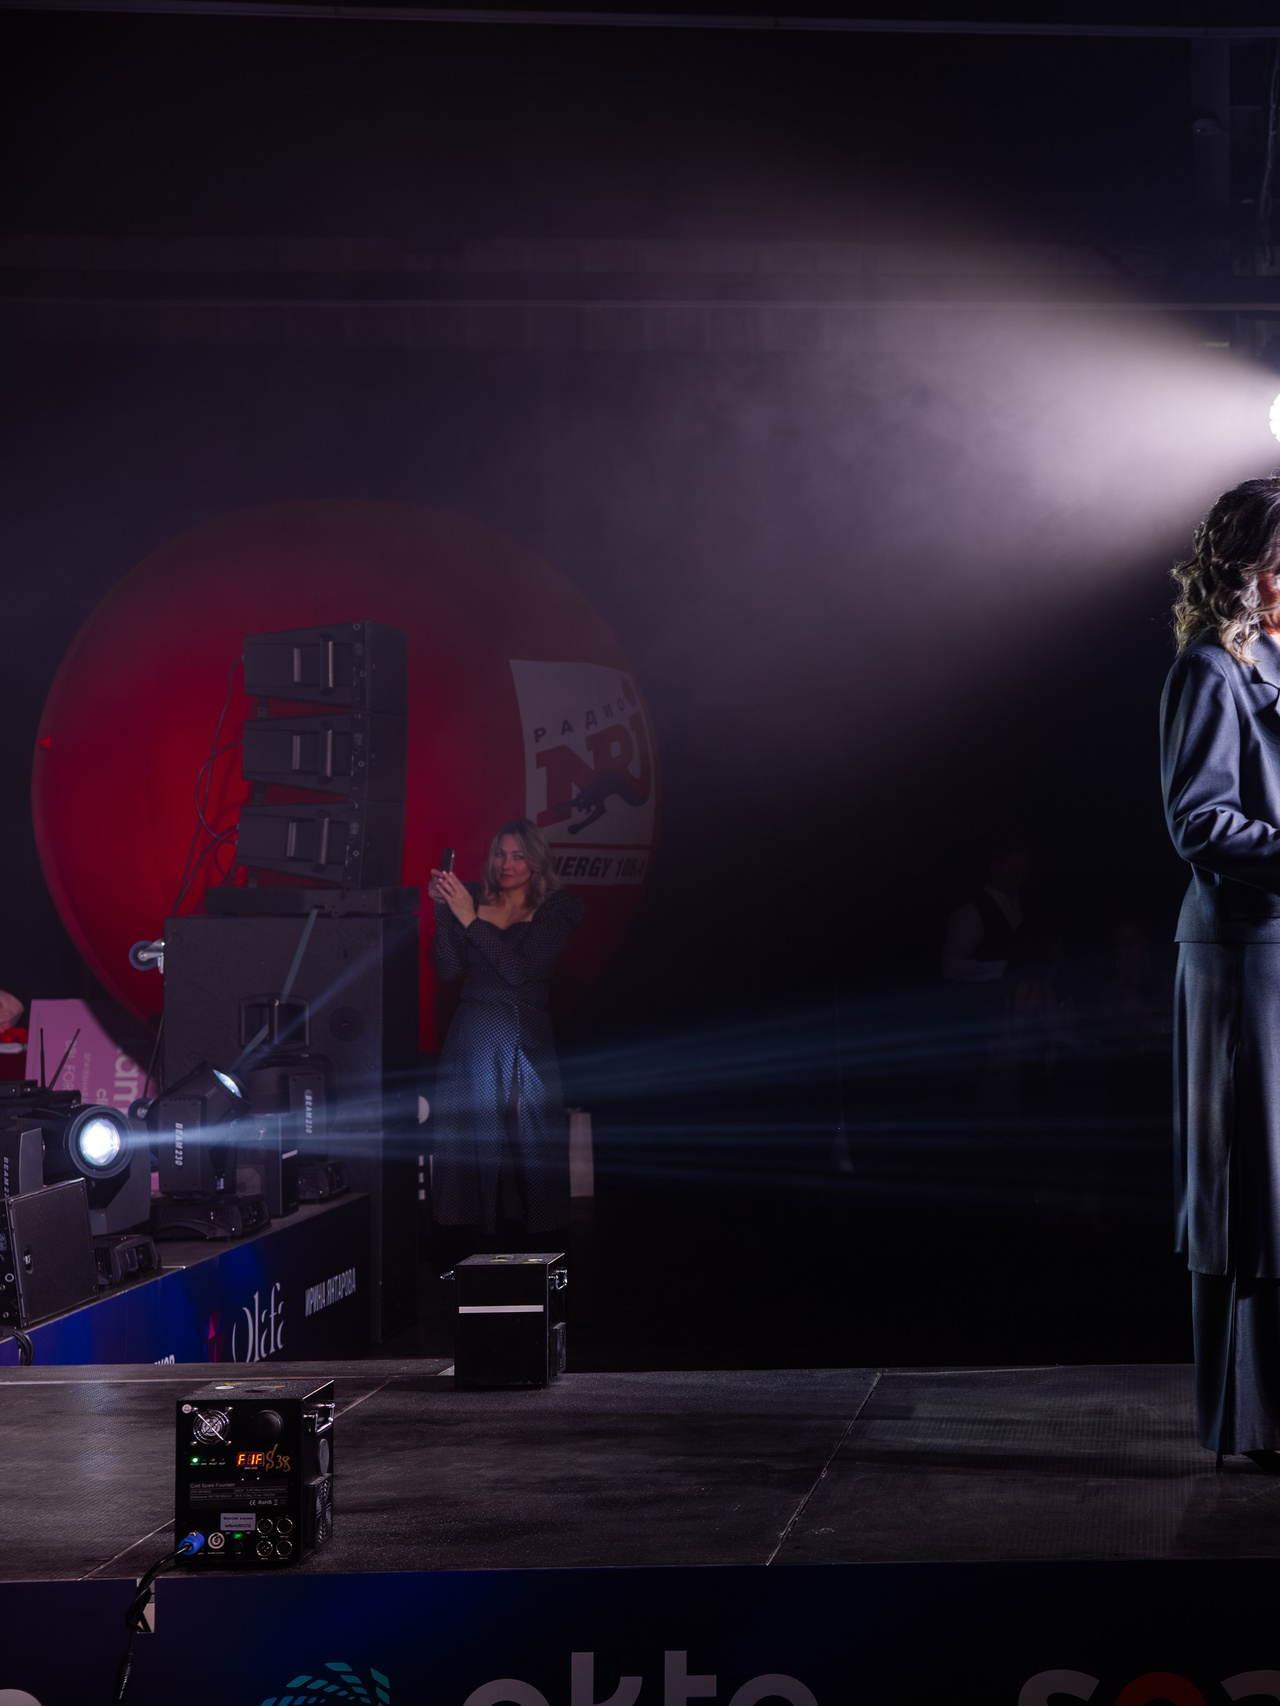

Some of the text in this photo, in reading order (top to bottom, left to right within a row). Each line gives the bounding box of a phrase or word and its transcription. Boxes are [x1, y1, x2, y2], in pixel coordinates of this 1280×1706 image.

[533, 697, 625, 743] РАДИО
[555, 856, 614, 878] ERGY
[304, 1095, 313, 1122] BEAM
[174, 1122, 184, 1167] BEAM 230
